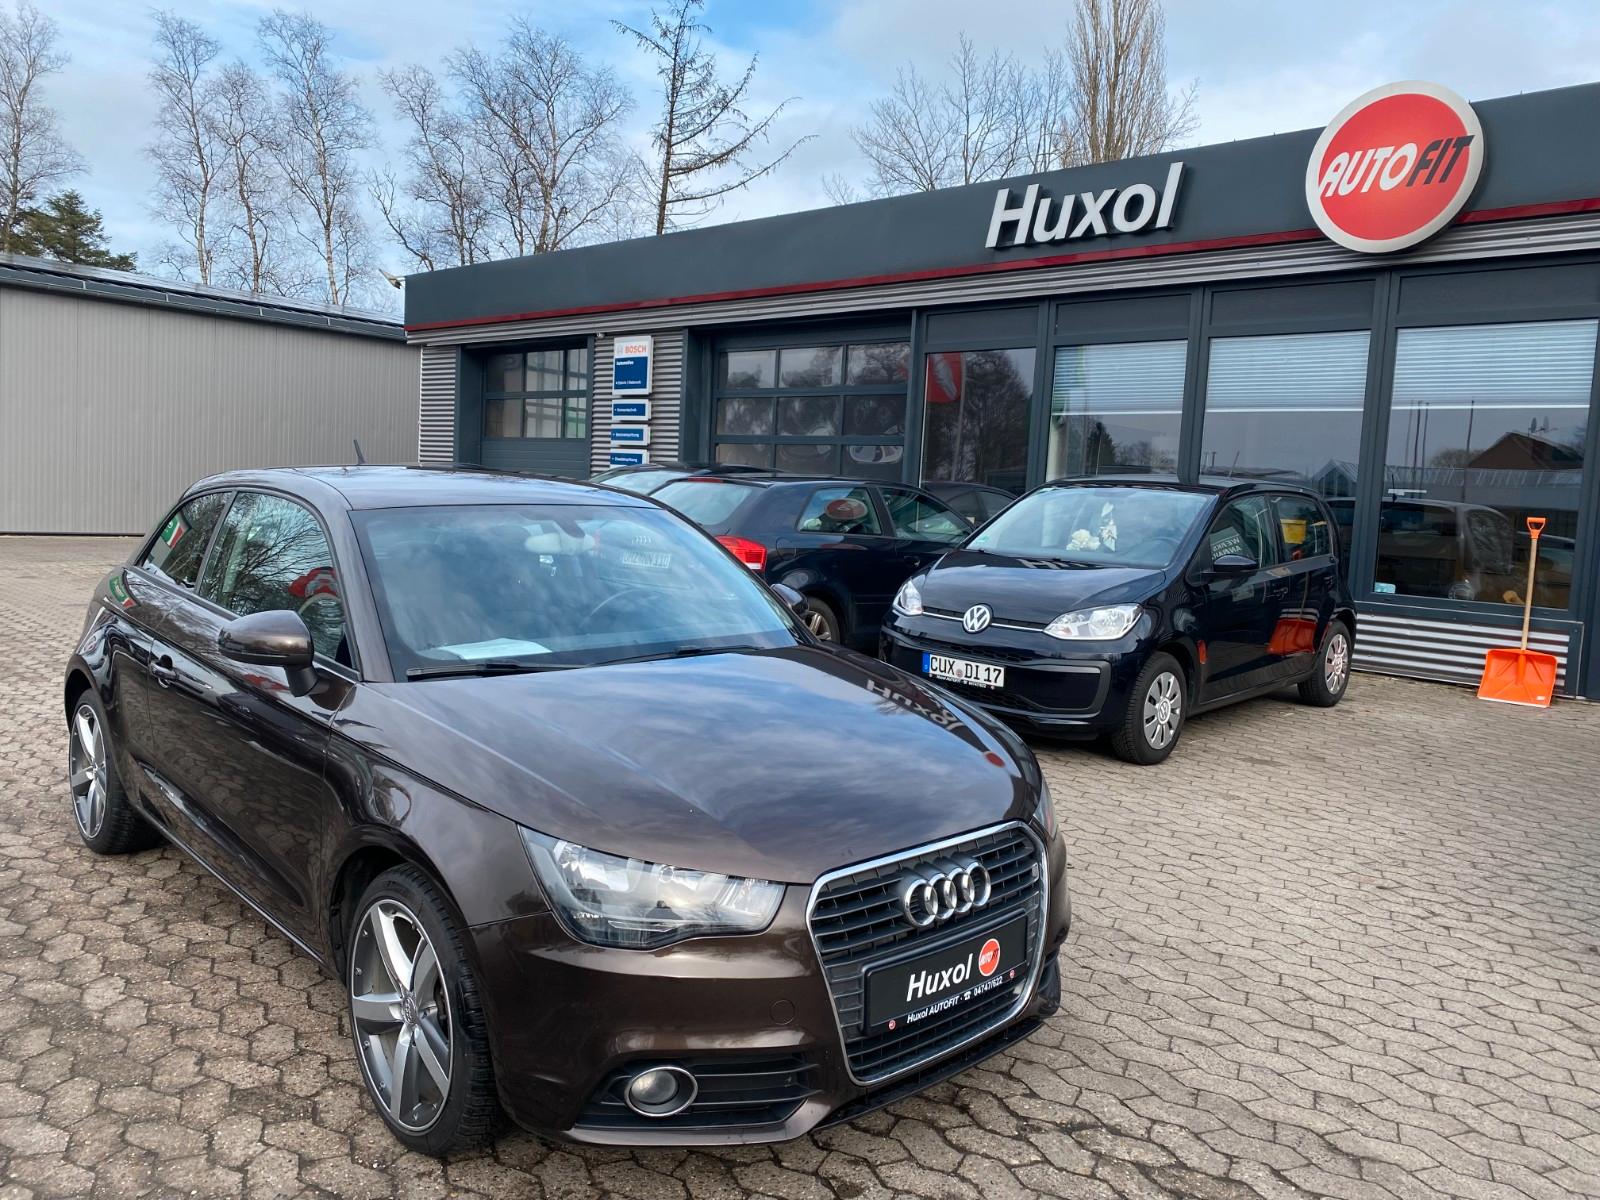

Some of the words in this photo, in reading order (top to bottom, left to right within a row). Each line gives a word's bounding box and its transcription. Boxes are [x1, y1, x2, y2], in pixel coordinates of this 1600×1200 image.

[1319, 134, 1475, 198] AUTOFIT
[985, 161, 1184, 249] Huxol
[624, 344, 647, 354] BOSCH
[930, 656, 956, 676] CUX
[964, 662, 980, 681] DI
[984, 667, 1002, 684] 17
[906, 952, 974, 1002] Huxol
[906, 1006, 929, 1024] Huxol
[928, 995, 960, 1016] AUTOFIT
